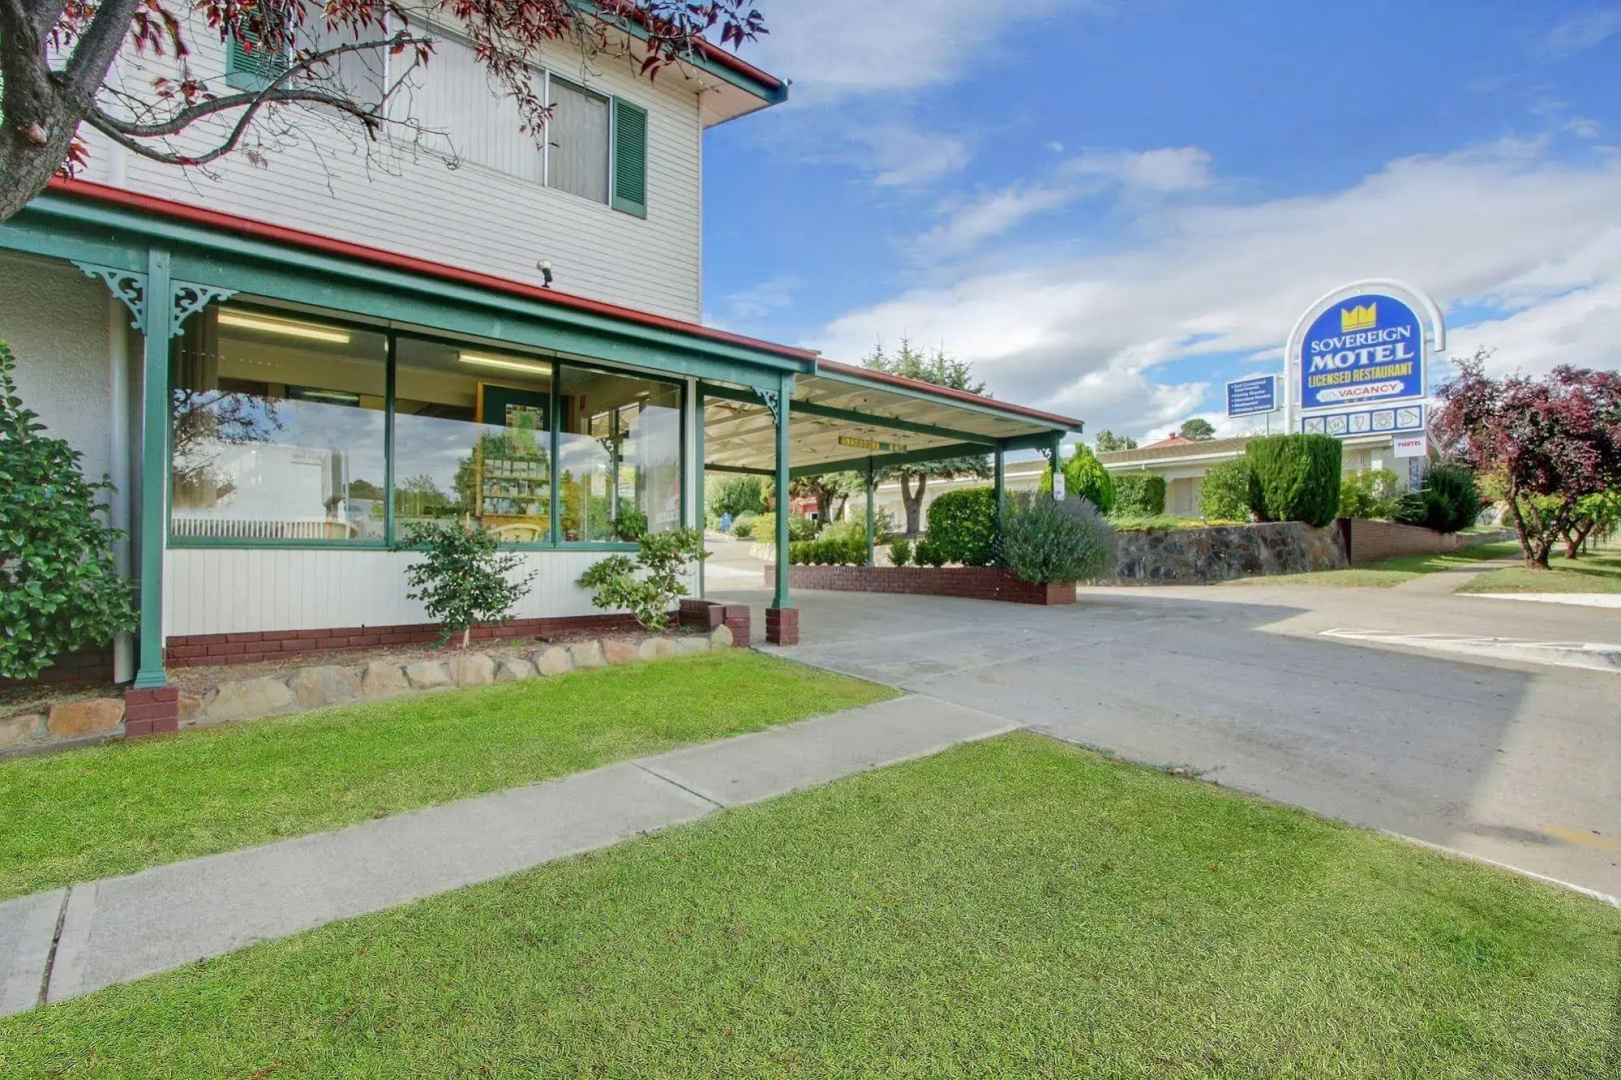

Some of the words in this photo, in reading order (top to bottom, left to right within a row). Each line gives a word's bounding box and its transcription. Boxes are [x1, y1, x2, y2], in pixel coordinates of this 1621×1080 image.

[1311, 325, 1411, 353] SOVEREIGN
[1308, 342, 1414, 372] MOTEL
[1308, 370, 1351, 388] LICENSED
[1353, 361, 1413, 382] RESTAURANT
[1338, 383, 1398, 397] VACANCY
